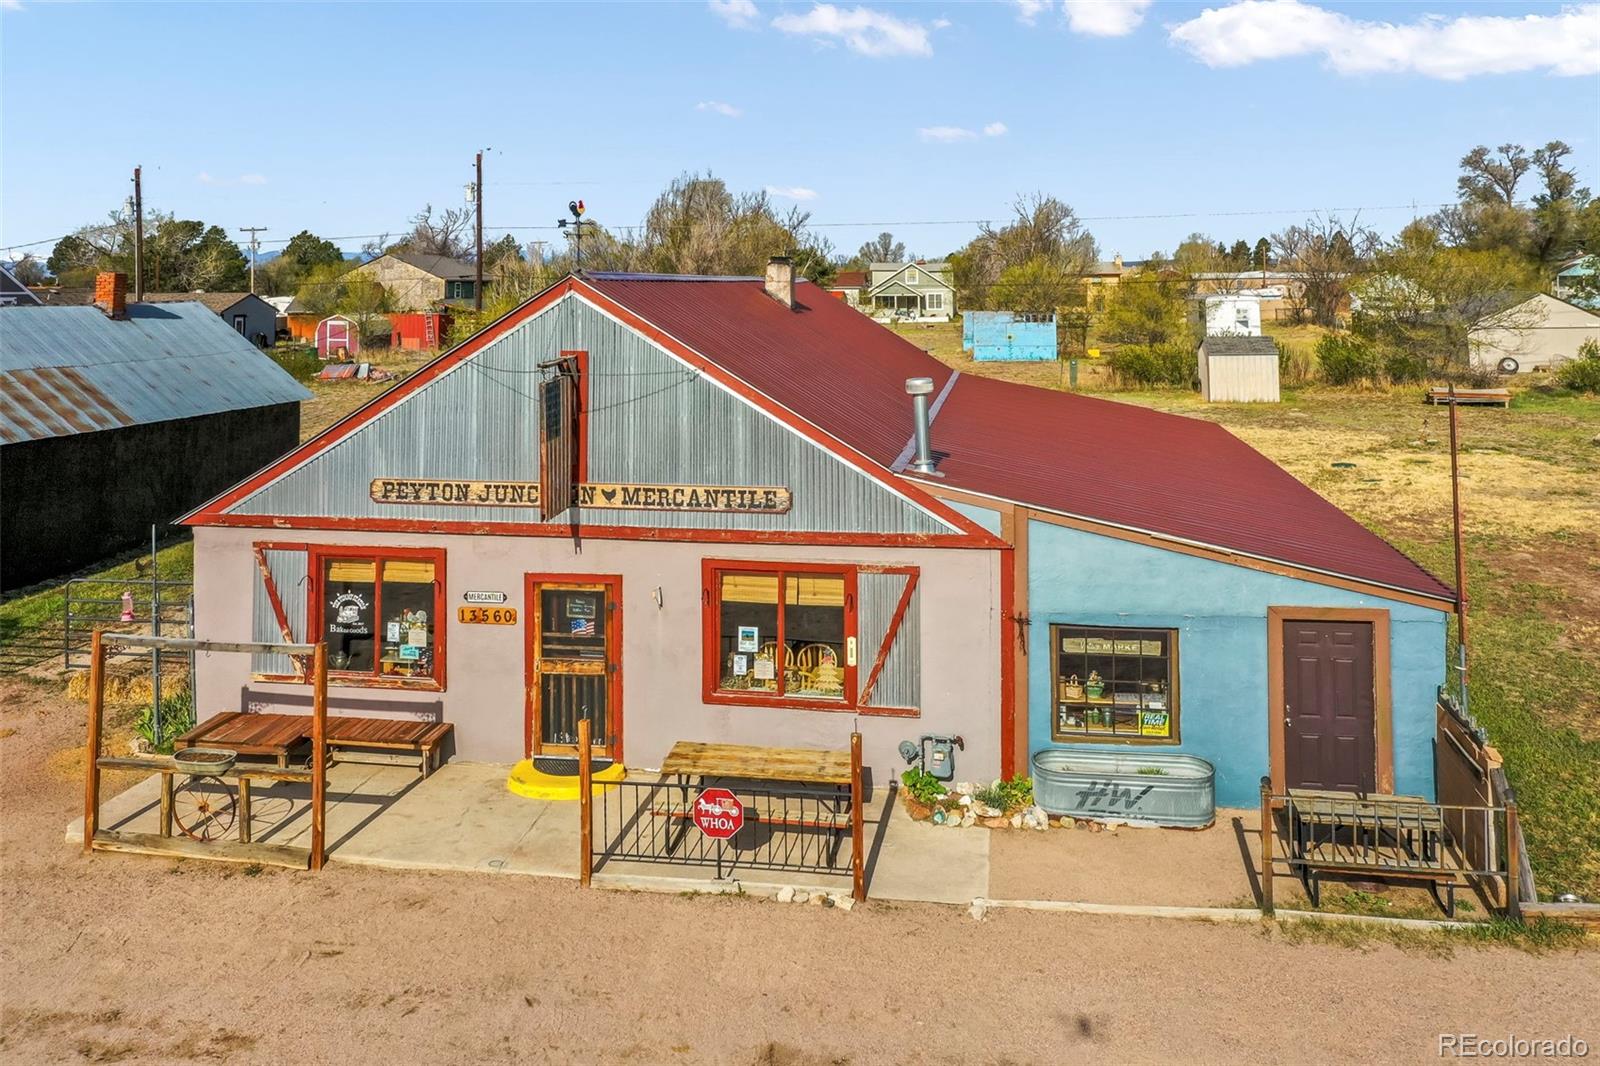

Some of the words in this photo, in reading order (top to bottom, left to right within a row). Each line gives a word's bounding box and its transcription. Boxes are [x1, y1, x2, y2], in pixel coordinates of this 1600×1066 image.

[382, 481, 470, 501] PEYTON
[478, 484, 596, 505] JUNCN
[621, 486, 778, 510] MERCANTILE
[468, 593, 502, 602] MERCANTILE
[461, 609, 512, 623] 13560
[700, 816, 735, 830] WHOA
